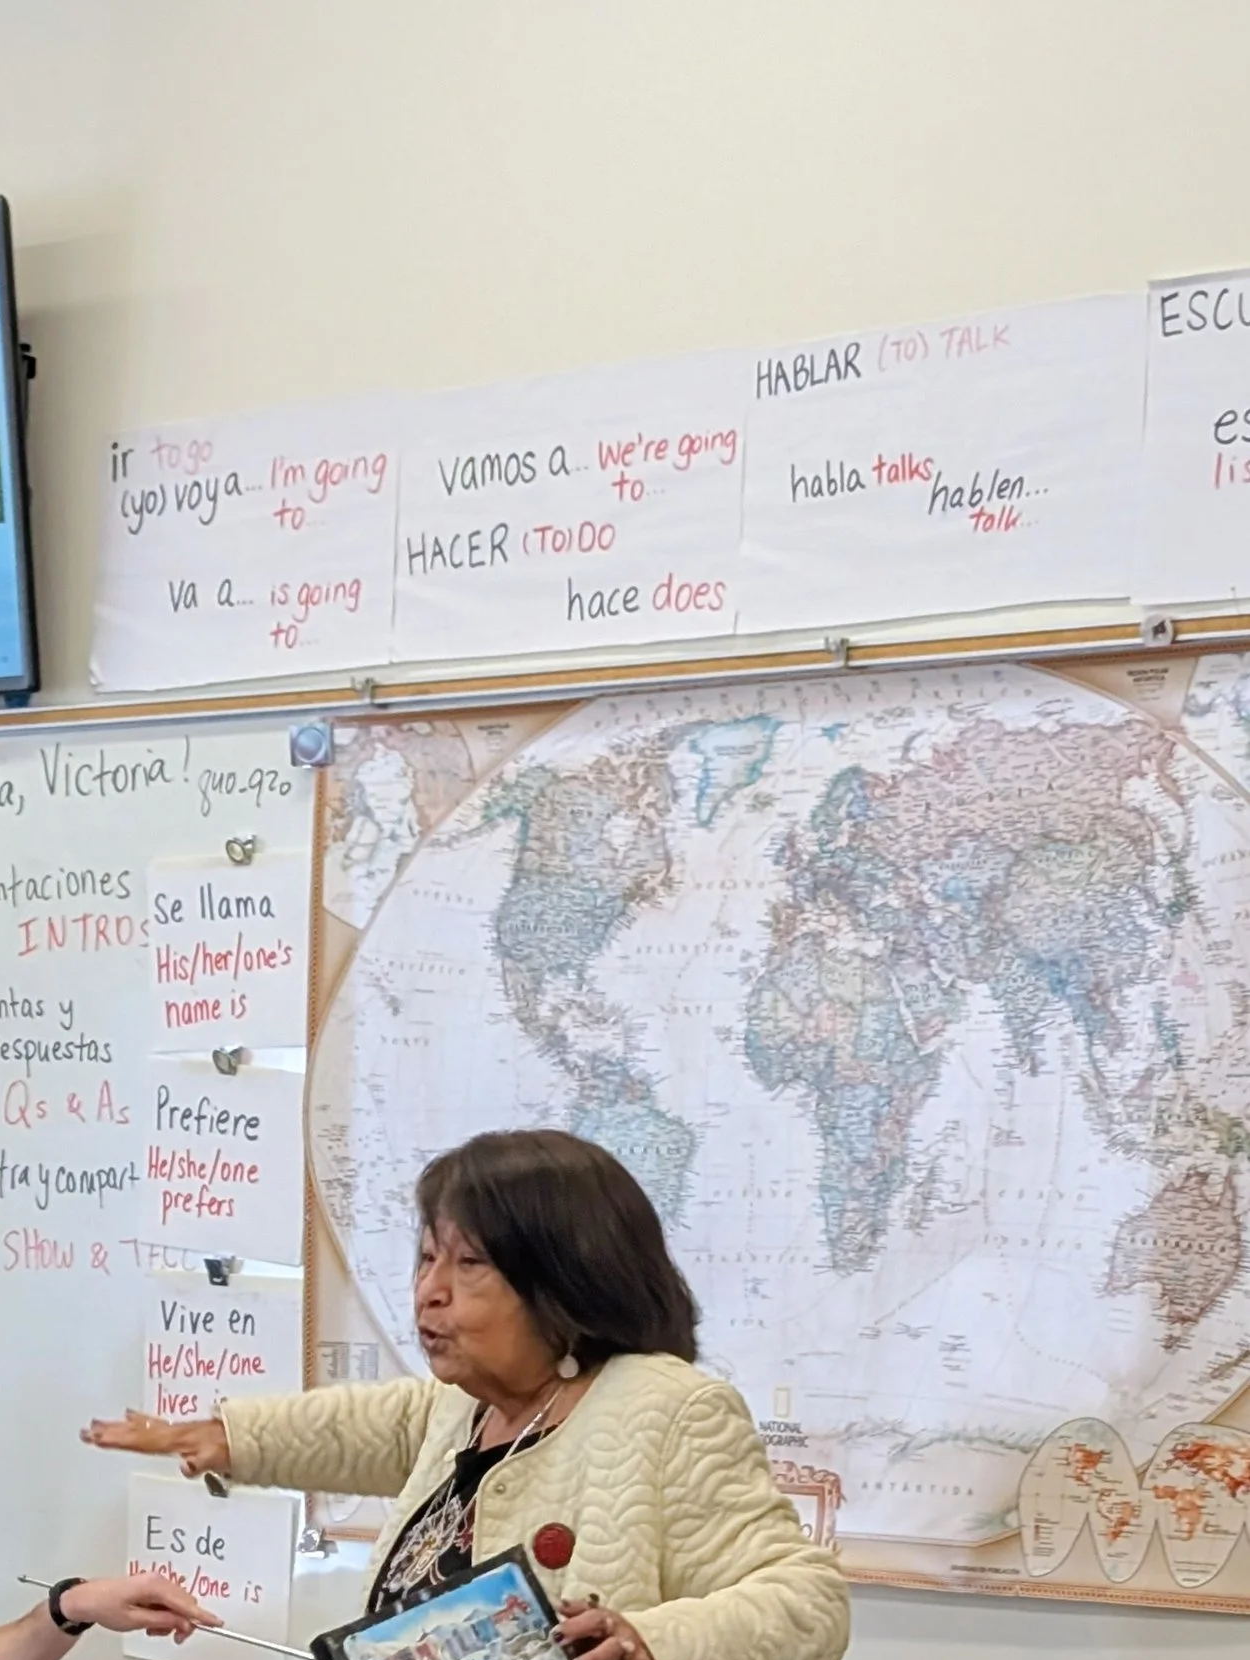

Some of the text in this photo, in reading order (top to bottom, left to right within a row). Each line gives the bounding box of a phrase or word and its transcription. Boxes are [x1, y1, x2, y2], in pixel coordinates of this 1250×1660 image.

[755, 324, 1011, 400] HABLAR (TO) TALK
[111, 438, 215, 483] ir to go
[676, 427, 738, 473] going
[119, 484, 168, 535] (yo)
[173, 480, 219, 526] voy
[270, 456, 307, 490] I'm
[313, 450, 388, 504] going
[790, 453, 935, 503] habla talks
[407, 522, 509, 576] HACER
[577, 520, 617, 553] DO
[270, 578, 291, 606] is
[296, 576, 363, 624] going
[566, 572, 726, 622] hace does
[40, 735, 191, 798] Victoria!
[199, 884, 276, 922] llama
[17, 914, 150, 957] INTROS
[156, 932, 292, 985] His/her/one's
[59, 996, 75, 1031] y
[165, 990, 248, 1029] name is
[3, 1080, 131, 1128] Qs & As
[155, 1084, 261, 1142] Prefiere
[147, 1145, 261, 1184] He/she/one
[36, 1169, 52, 1210] y
[161, 1185, 234, 1225] prefers
[3, 1227, 74, 1275] SHOW
[91, 1241, 112, 1276] &
[160, 1299, 256, 1337] Vive en
[157, 1383, 198, 1416] lives
[760, 1434, 809, 1448] OGRAPHIC
[145, 1515, 226, 1560] Es de
[244, 1582, 263, 1603] is
